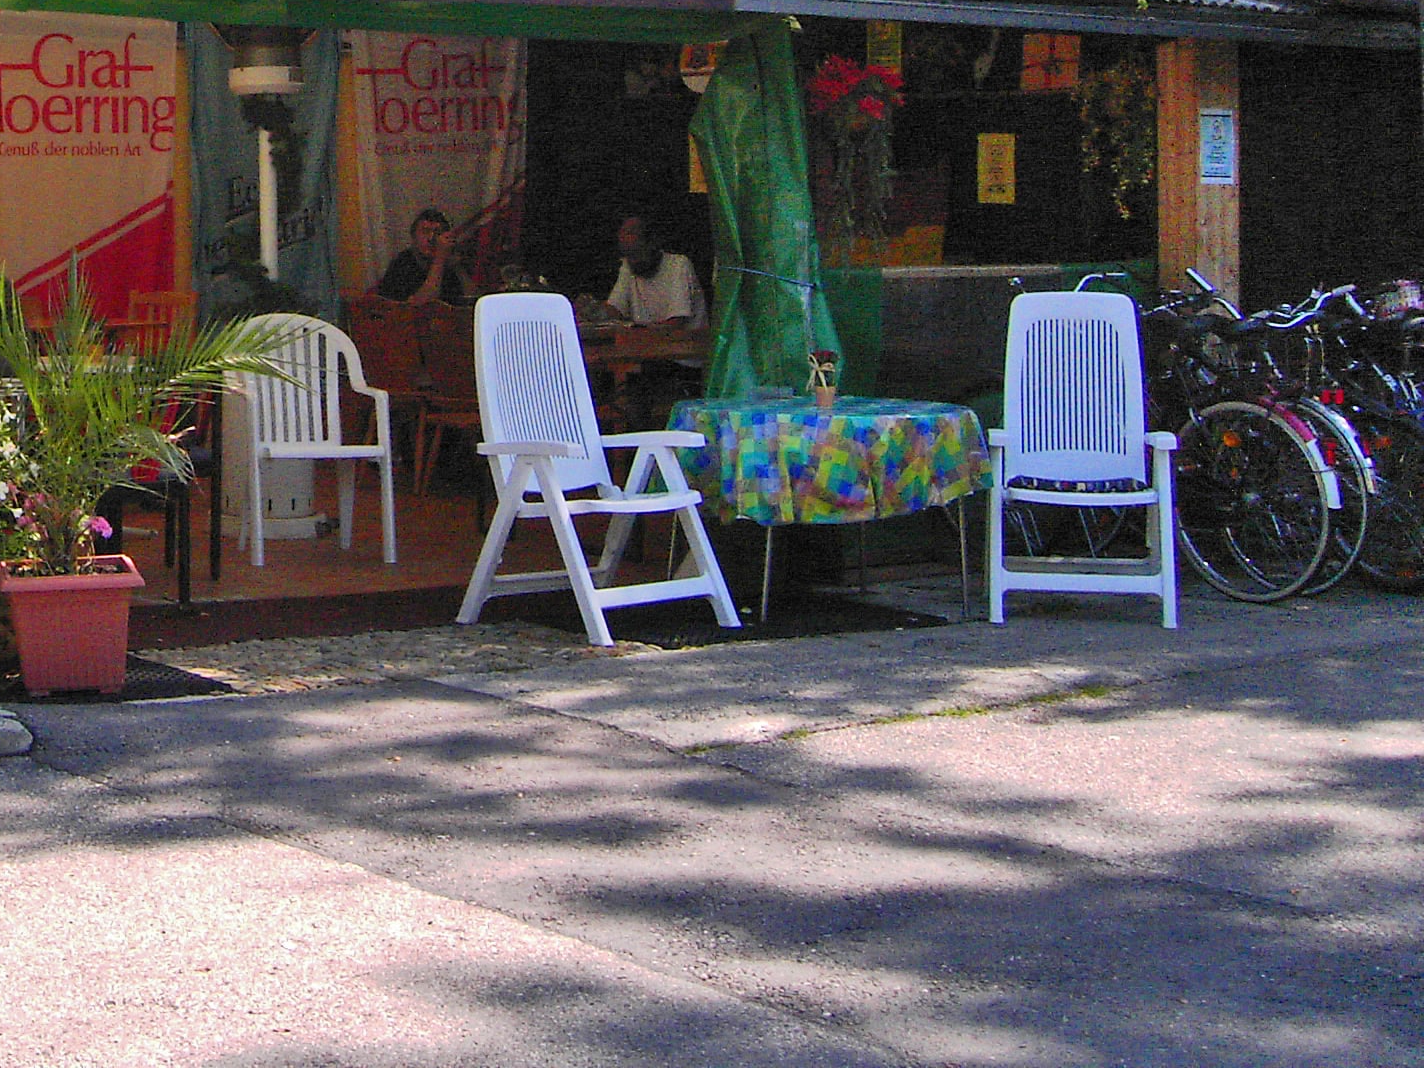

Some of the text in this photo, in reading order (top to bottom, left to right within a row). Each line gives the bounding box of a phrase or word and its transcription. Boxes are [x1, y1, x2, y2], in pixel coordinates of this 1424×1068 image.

[31, 32, 154, 89] Graf
[401, 37, 506, 90] Graf
[44, 140, 68, 156] der
[71, 140, 120, 157] noblen
